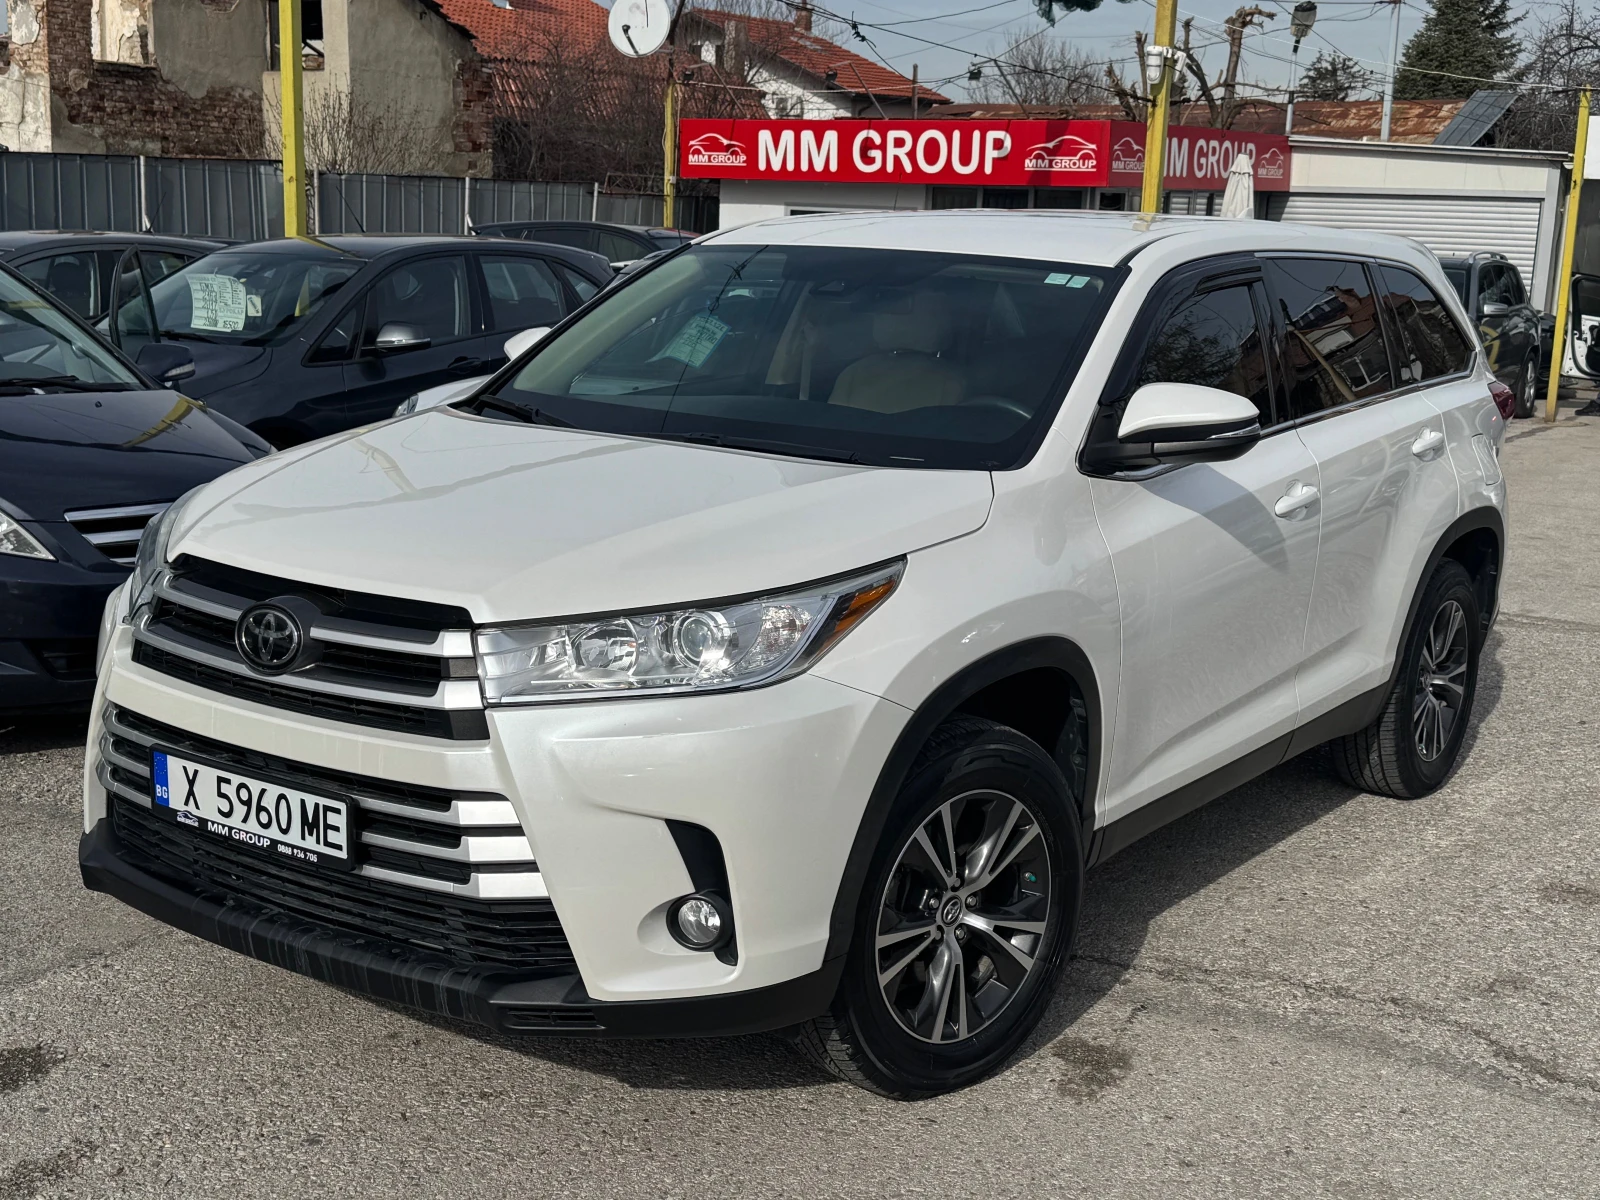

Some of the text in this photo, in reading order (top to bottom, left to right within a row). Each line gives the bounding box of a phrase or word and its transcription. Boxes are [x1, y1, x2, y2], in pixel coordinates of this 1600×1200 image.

[688, 154, 747, 163] MM GROUP
[758, 129, 1012, 175] MM GROUP
[1163, 137, 1189, 178] M
[1024, 158, 1096, 169] MM GROUP
[1112, 161, 1125, 169] MM
[1257, 167, 1284, 176] MM GROUP
[156, 784, 168, 799] BG
[182, 765, 343, 851] X 5960 ME
[207, 821, 271, 848] MM GROUP
[277, 843, 318, 862] 0888 936 705
